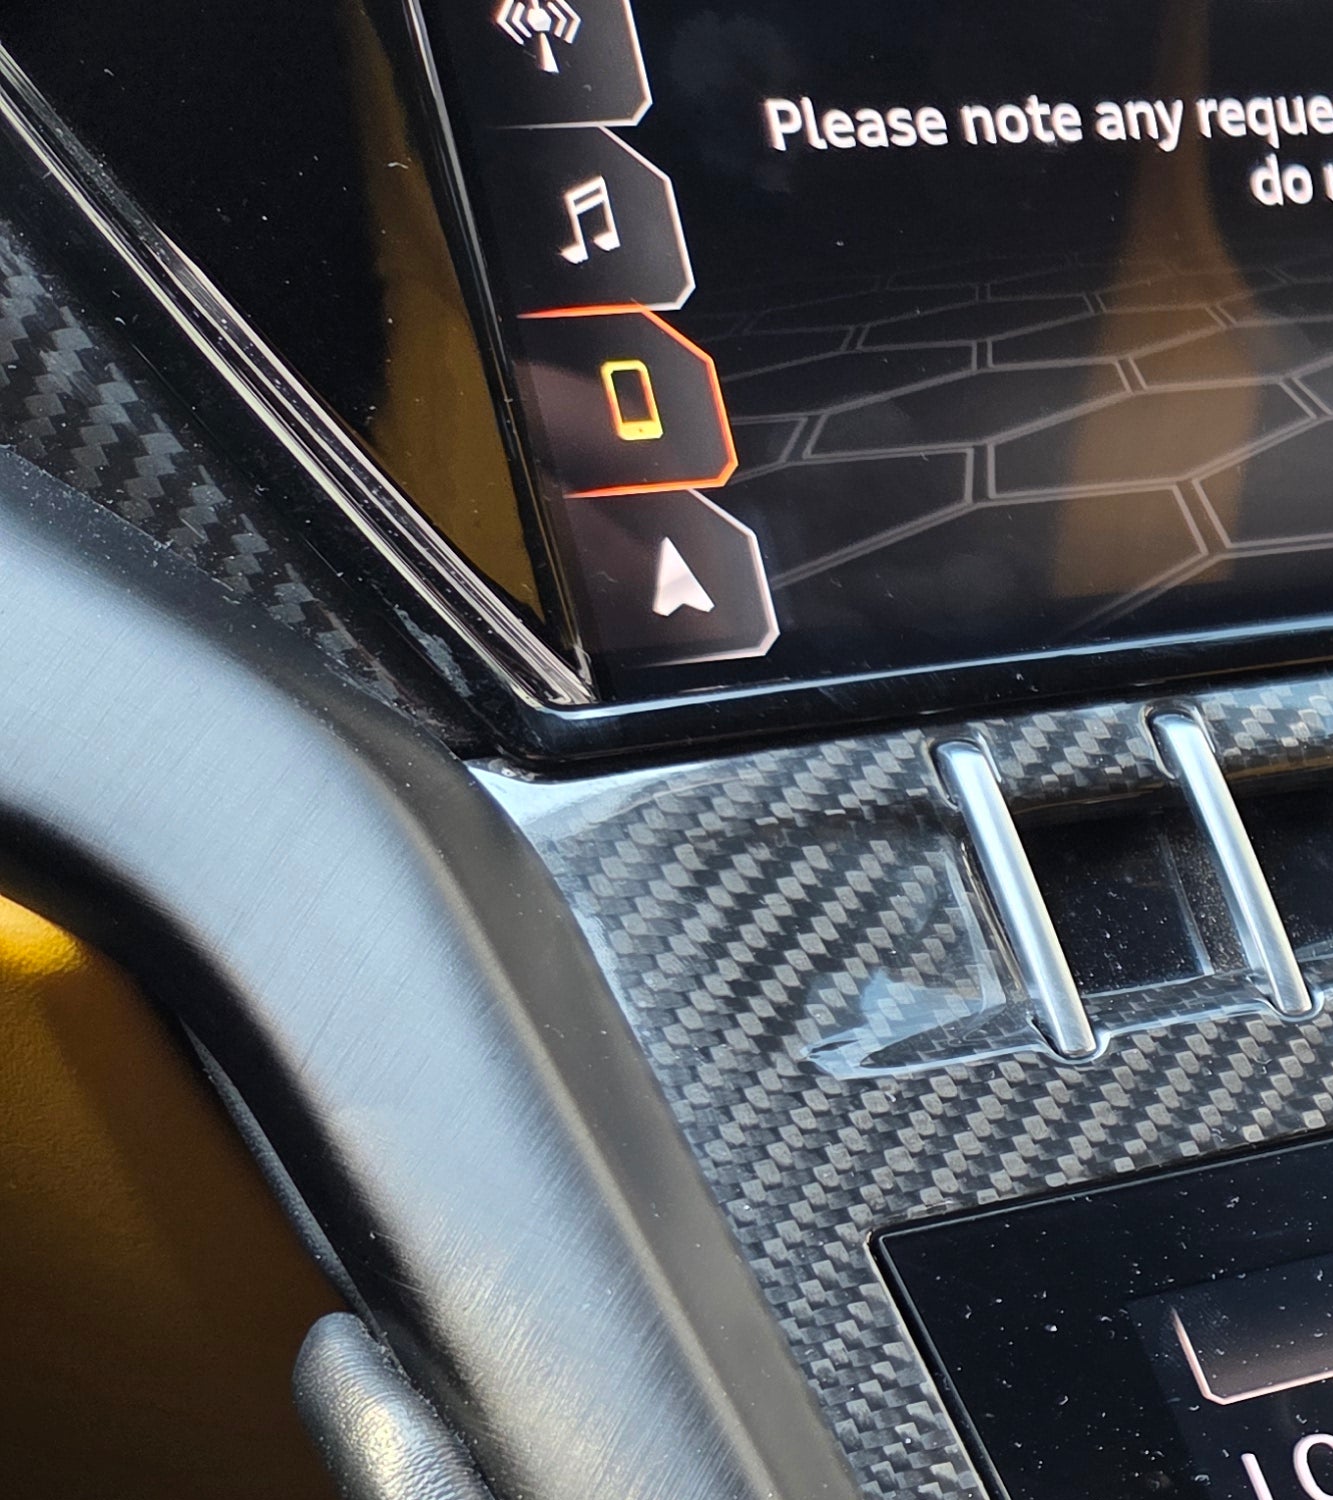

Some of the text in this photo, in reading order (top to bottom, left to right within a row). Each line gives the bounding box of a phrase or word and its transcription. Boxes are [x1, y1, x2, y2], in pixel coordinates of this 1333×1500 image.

[764, 96, 948, 151] Please
[959, 94, 1082, 146] note
[1096, 97, 1185, 153] any
[1250, 153, 1313, 206] do
